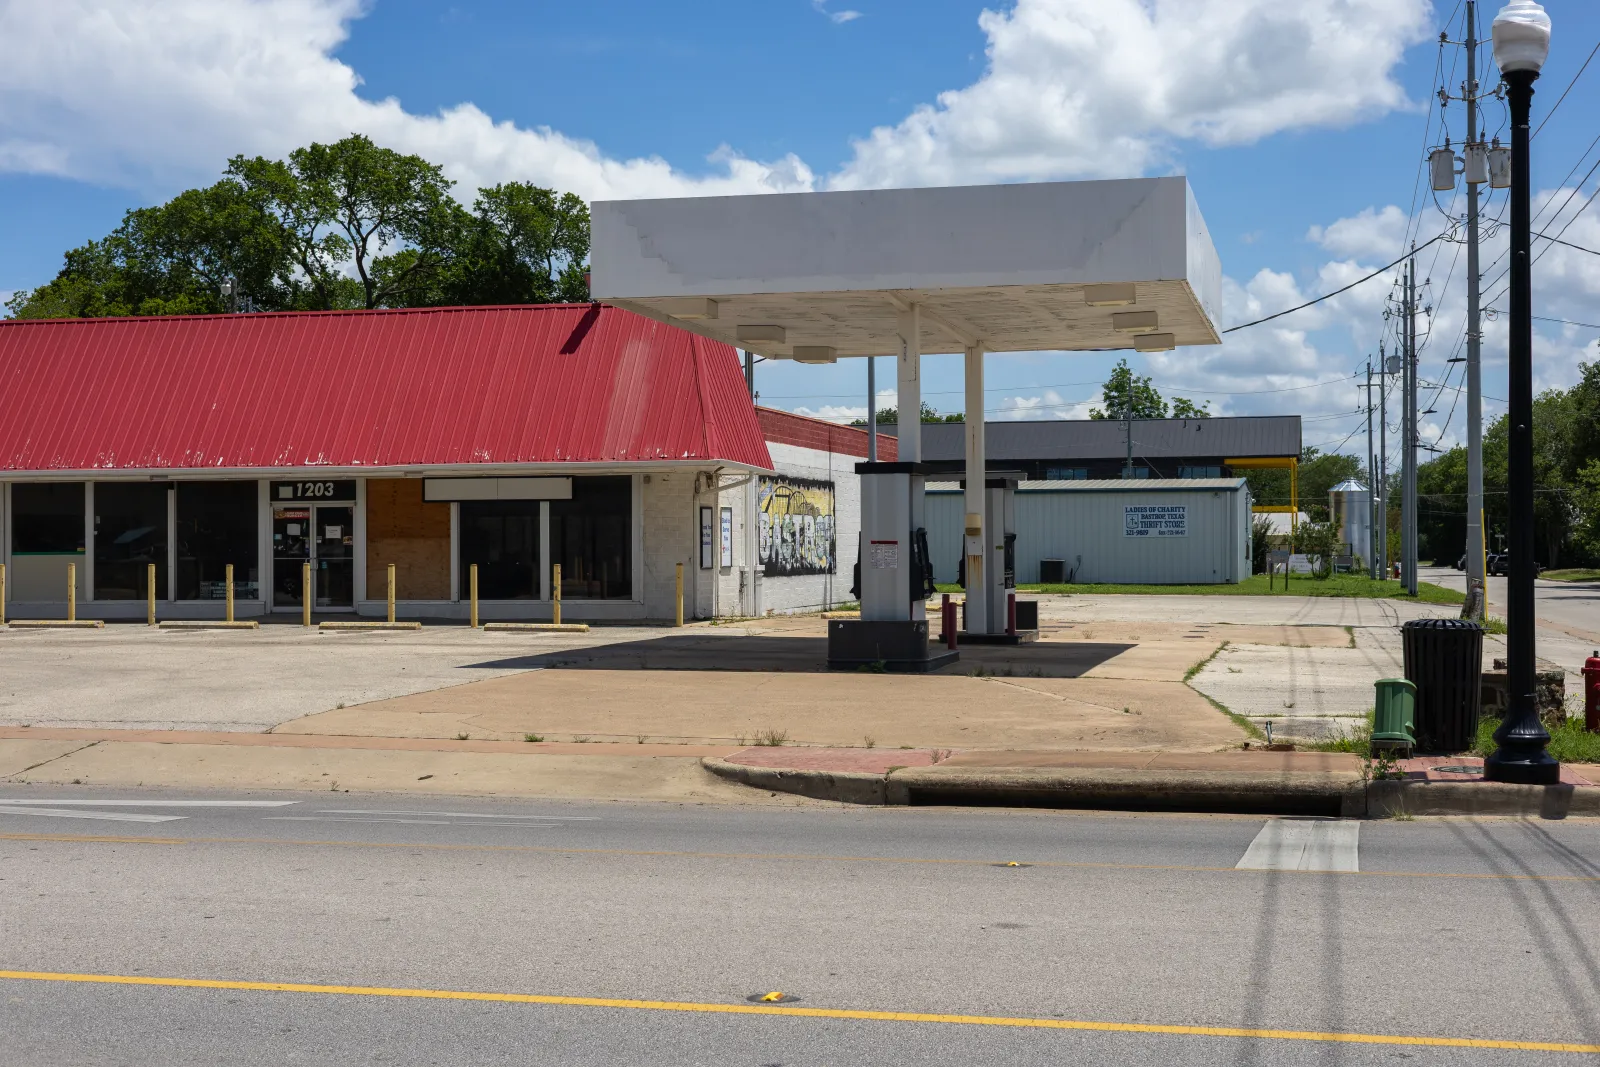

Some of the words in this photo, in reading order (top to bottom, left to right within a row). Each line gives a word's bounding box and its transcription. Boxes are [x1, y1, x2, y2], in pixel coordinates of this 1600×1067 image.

[297, 482, 334, 497] 1203
[1140, 520, 1163, 529] THRIFT
[1164, 520, 1185, 529] STORE
